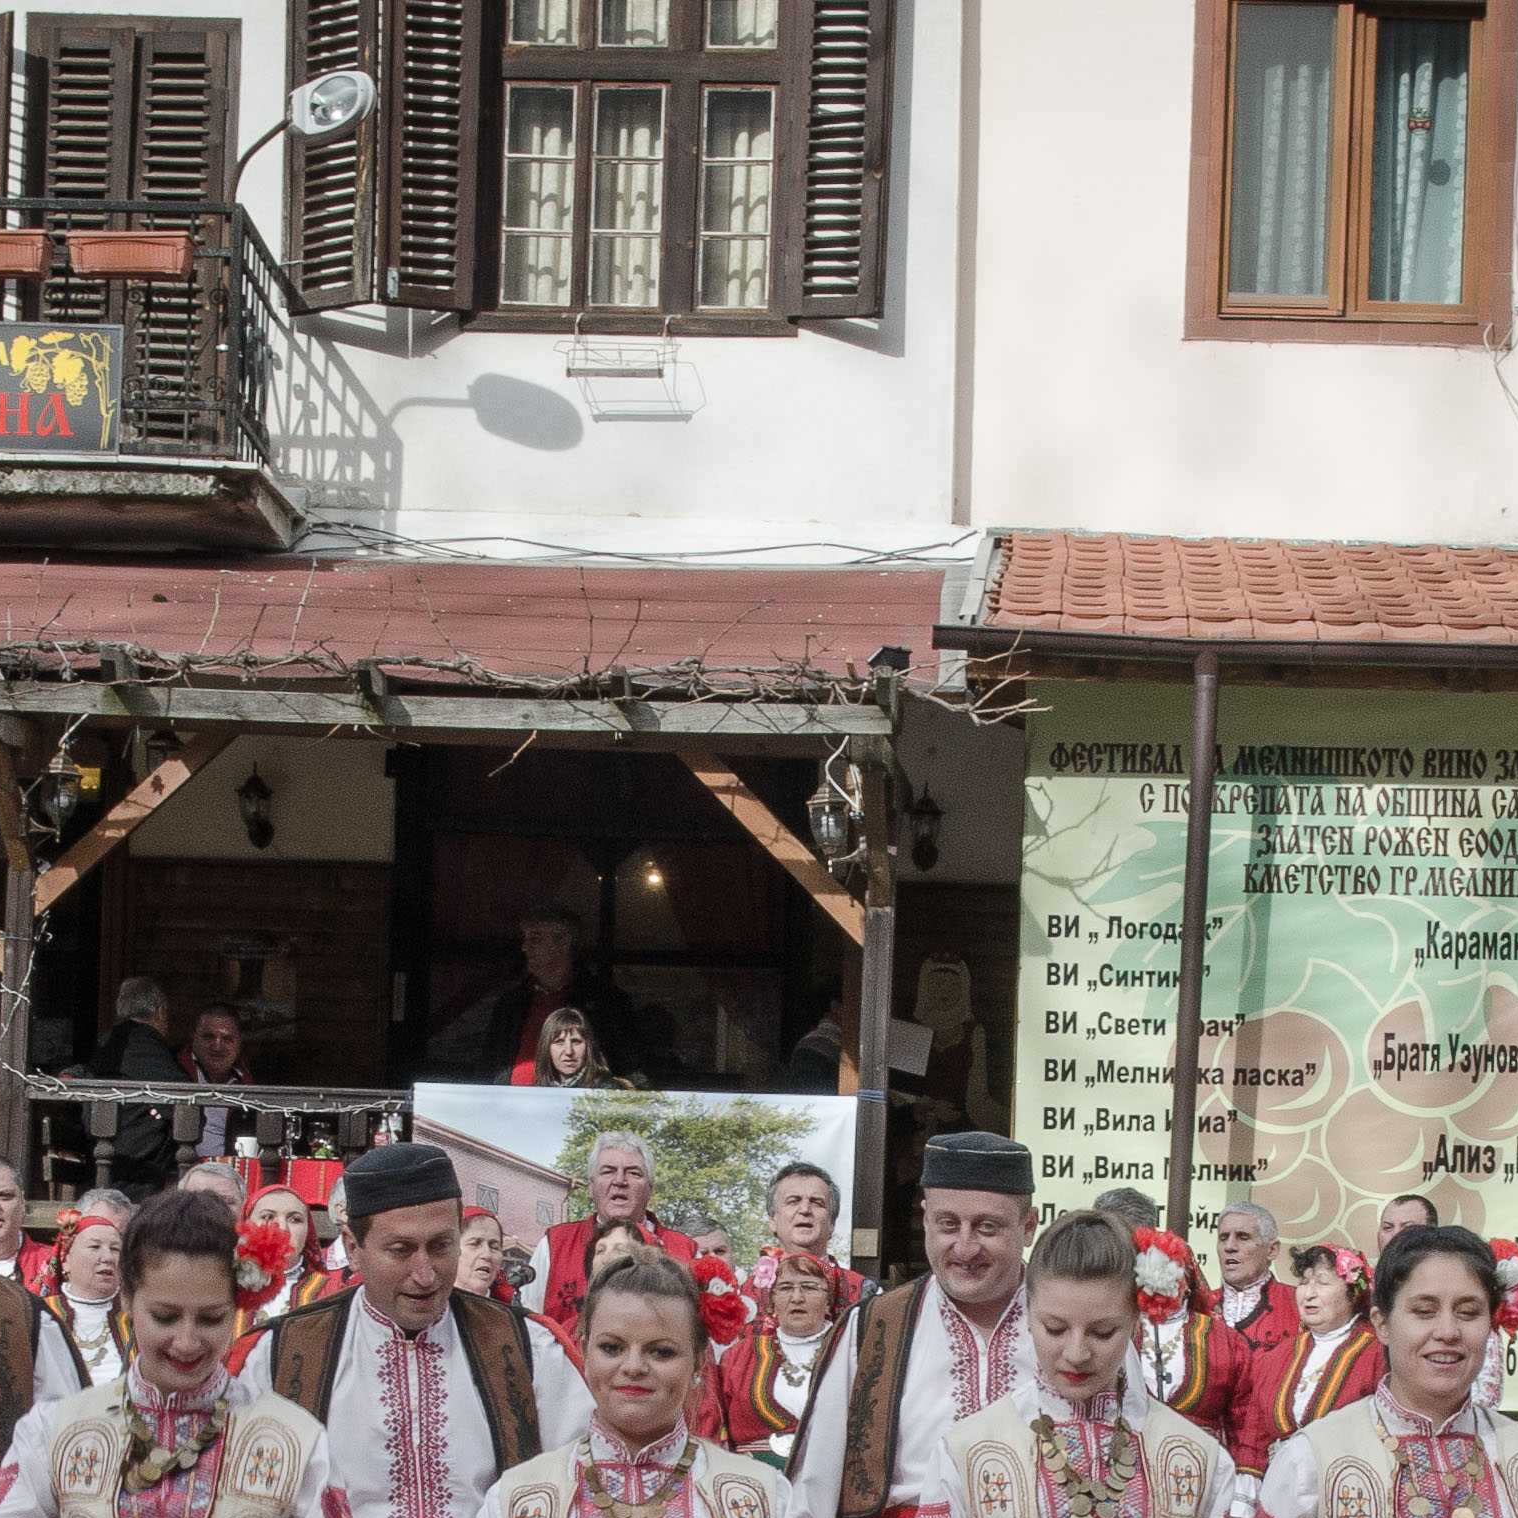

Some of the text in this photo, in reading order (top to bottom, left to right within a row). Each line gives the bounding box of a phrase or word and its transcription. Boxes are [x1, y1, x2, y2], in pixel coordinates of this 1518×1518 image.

[1049, 742, 1184, 774] ФЕСТИВАЛ
[1234, 745, 1415, 778] МЕЛНИШКОТО
[1422, 748, 1487, 779] ВИНО
[1139, 783, 1155, 814] С
[1163, 783, 1326, 816] ПОКРЕПАТА
[1334, 785, 1368, 816] НА
[1376, 786, 1483, 826] ОБЩИНА
[1256, 824, 1354, 858] ЗЛАТЕН
[1363, 826, 1450, 858] РОЖЕН
[1242, 863, 1381, 895] КМЕТСТВО
[1046, 914, 1080, 938] ВИ
[1045, 962, 1079, 987] ВИ
[1044, 1010, 1078, 1035] ВИ
[1043, 1058, 1077, 1083] ВИ
[1084, 1059, 1225, 1088] „Мелника
[1042, 1106, 1076, 1131] ВИ
[1041, 1155, 1074, 1180] ВИ
